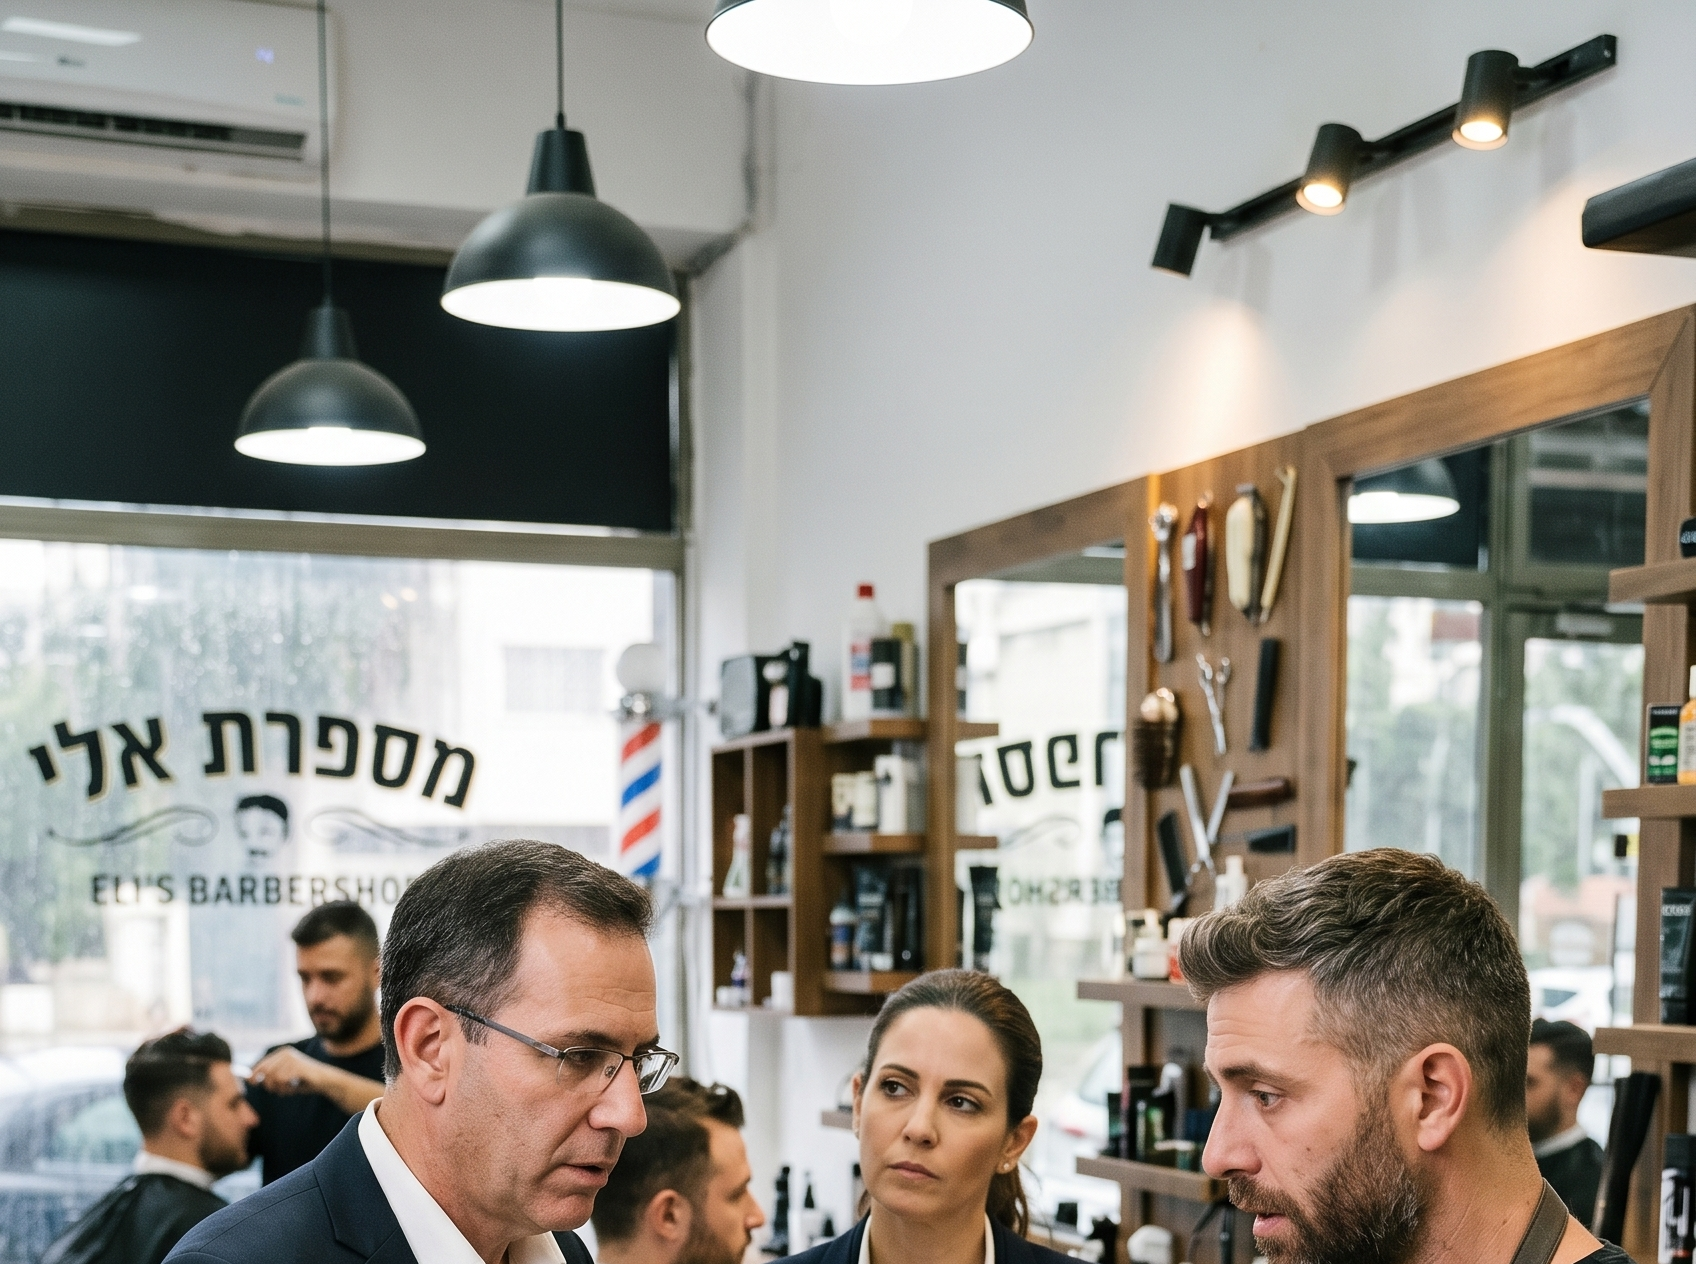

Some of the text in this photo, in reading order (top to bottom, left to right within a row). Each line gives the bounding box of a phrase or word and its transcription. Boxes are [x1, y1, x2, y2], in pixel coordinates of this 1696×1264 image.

[28, 710, 477, 809] מספרת אלי
[91, 874, 412, 905] ELI'S BARBERSHO
